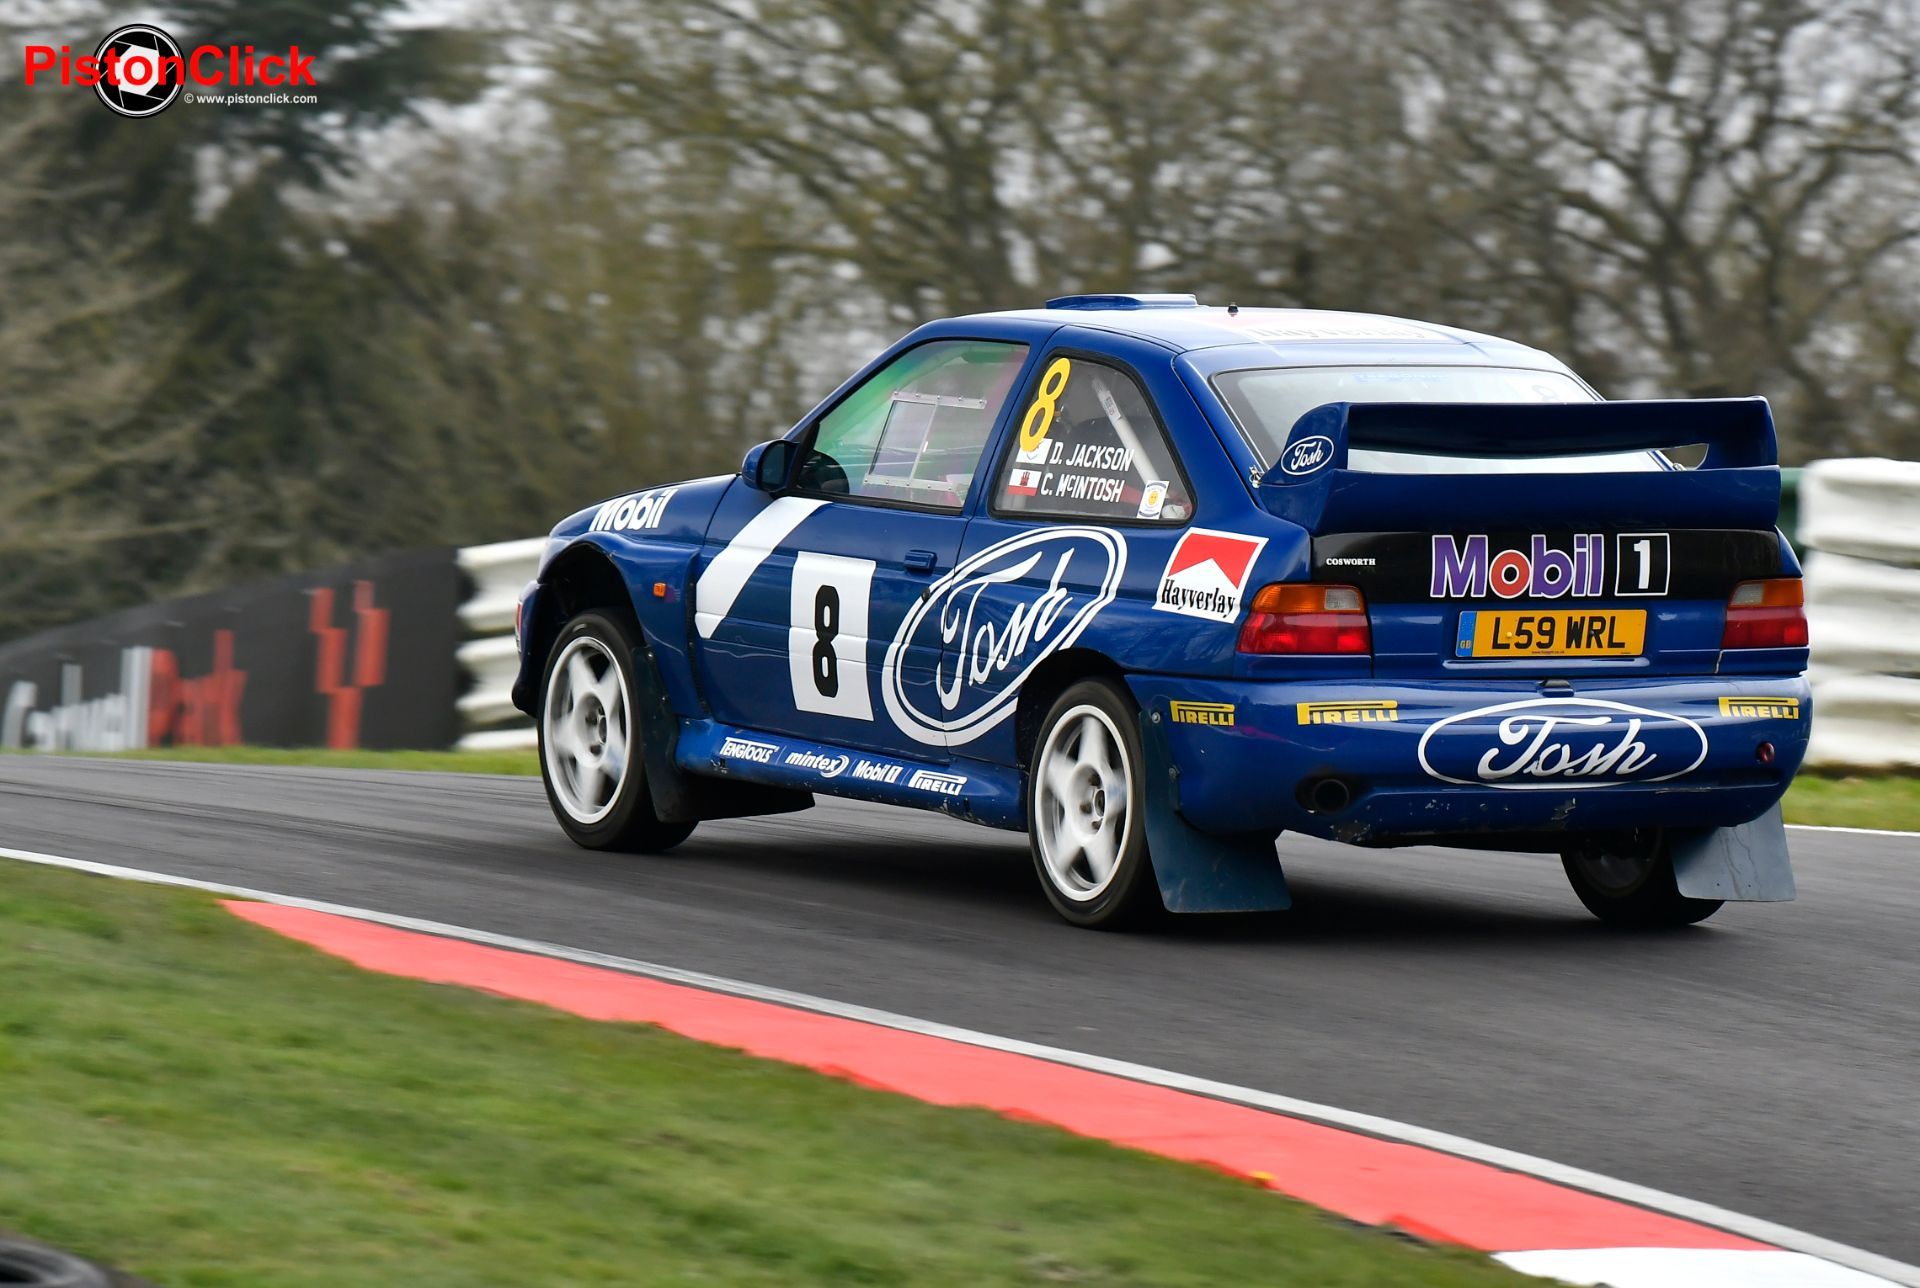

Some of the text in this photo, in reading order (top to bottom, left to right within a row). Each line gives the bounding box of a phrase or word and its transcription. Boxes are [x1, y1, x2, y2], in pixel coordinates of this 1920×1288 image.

[1020, 357, 1071, 453] 8
[1049, 442, 1135, 472] D. JACKSON
[1291, 441, 1324, 470] Tosh
[1041, 473, 1053, 496] C.
[589, 488, 679, 532] Mobil
[1326, 557, 1376, 566] COSWORTH
[1430, 534, 1652, 599] Mobil 1
[1161, 578, 1236, 618] Hayverlay
[812, 584, 840, 699] 8
[936, 547, 1074, 711] Tosh
[1491, 616, 1626, 650] L59 WRL
[1459, 640, 1472, 649] GB
[1170, 700, 1235, 726] PIRELLI
[1297, 700, 1398, 725] PIRELLI
[1718, 696, 1800, 719] PIRELLI
[785, 750, 843, 772] mintex
[1477, 715, 1657, 779] Tosh
[852, 759, 889, 781] Mobil
[908, 769, 968, 796] PIRELLI
